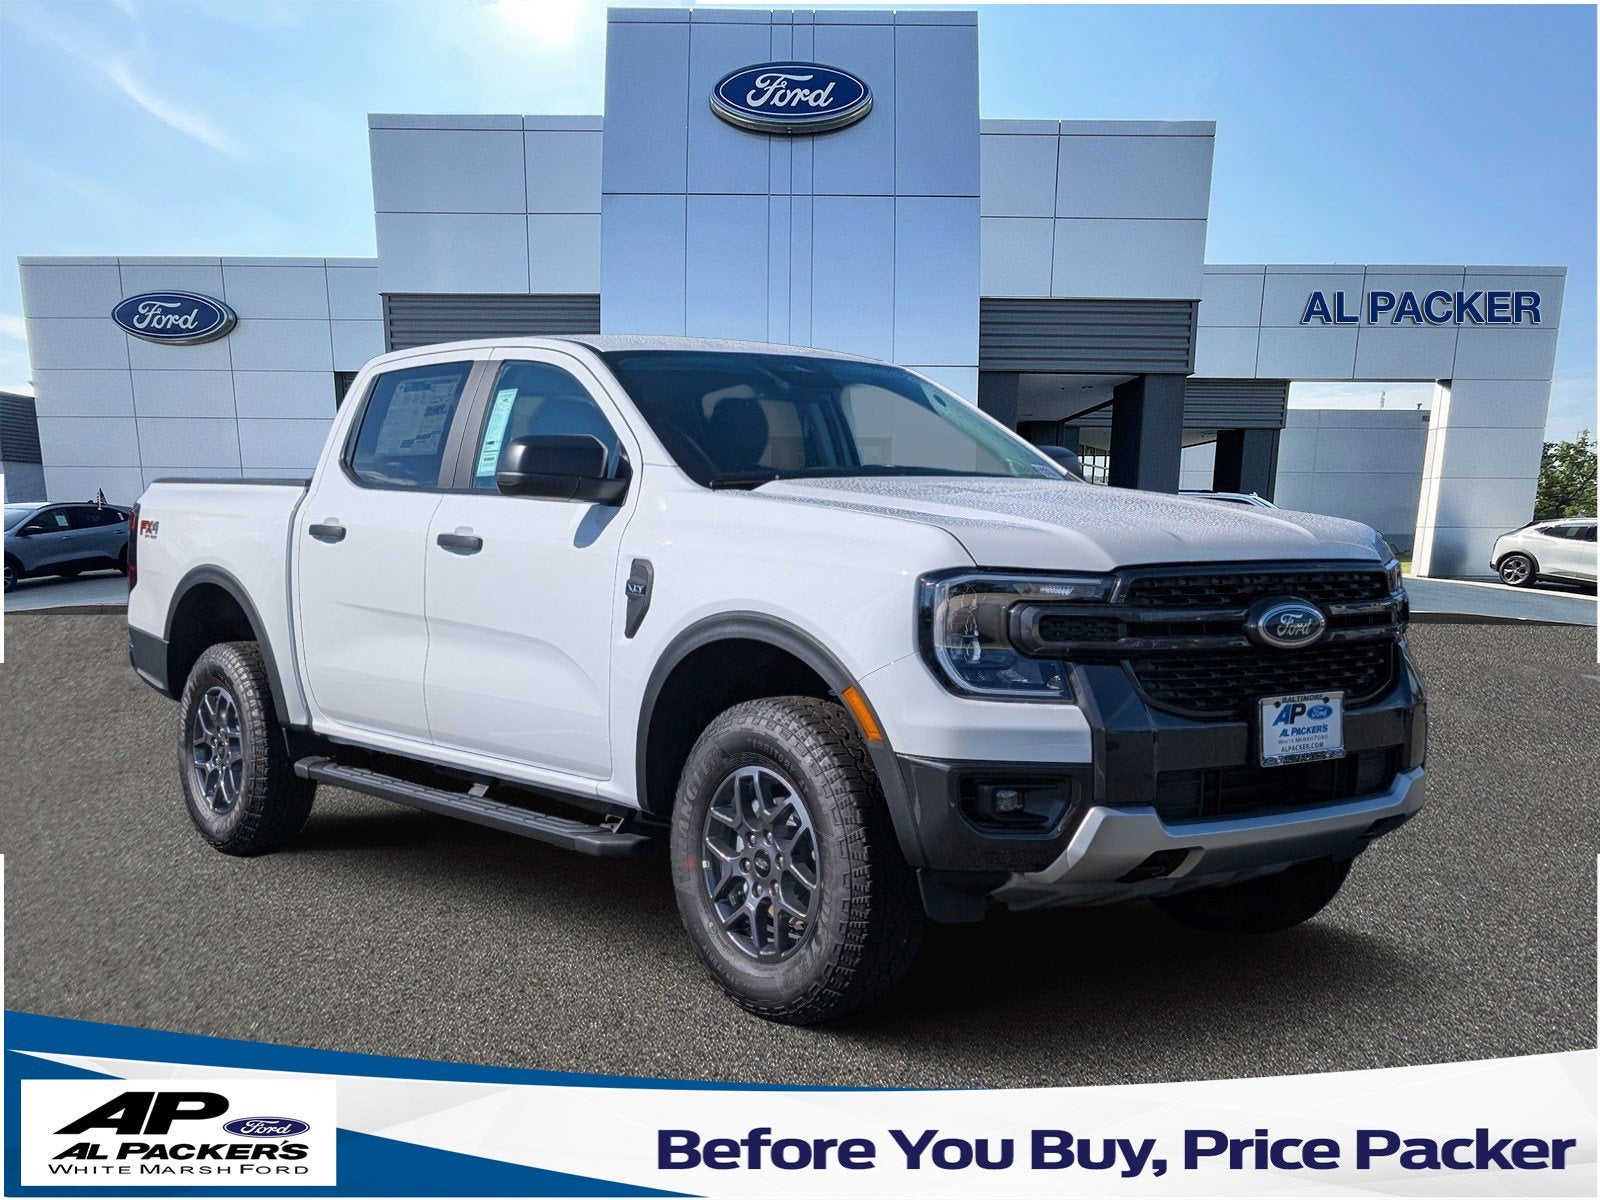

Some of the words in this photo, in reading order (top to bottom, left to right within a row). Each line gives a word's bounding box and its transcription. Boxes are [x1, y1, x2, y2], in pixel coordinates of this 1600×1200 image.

[746, 73, 836, 107] Ford
[133, 301, 199, 329] Ford
[1302, 290, 1359, 323] AL
[1369, 290, 1542, 324] PACKER
[1277, 613, 1312, 636] Ford
[1282, 693, 1325, 704] BALTIMORE
[1272, 703, 1307, 726] AP
[1279, 728, 1290, 738] AL
[1291, 723, 1329, 736] PACKER'S
